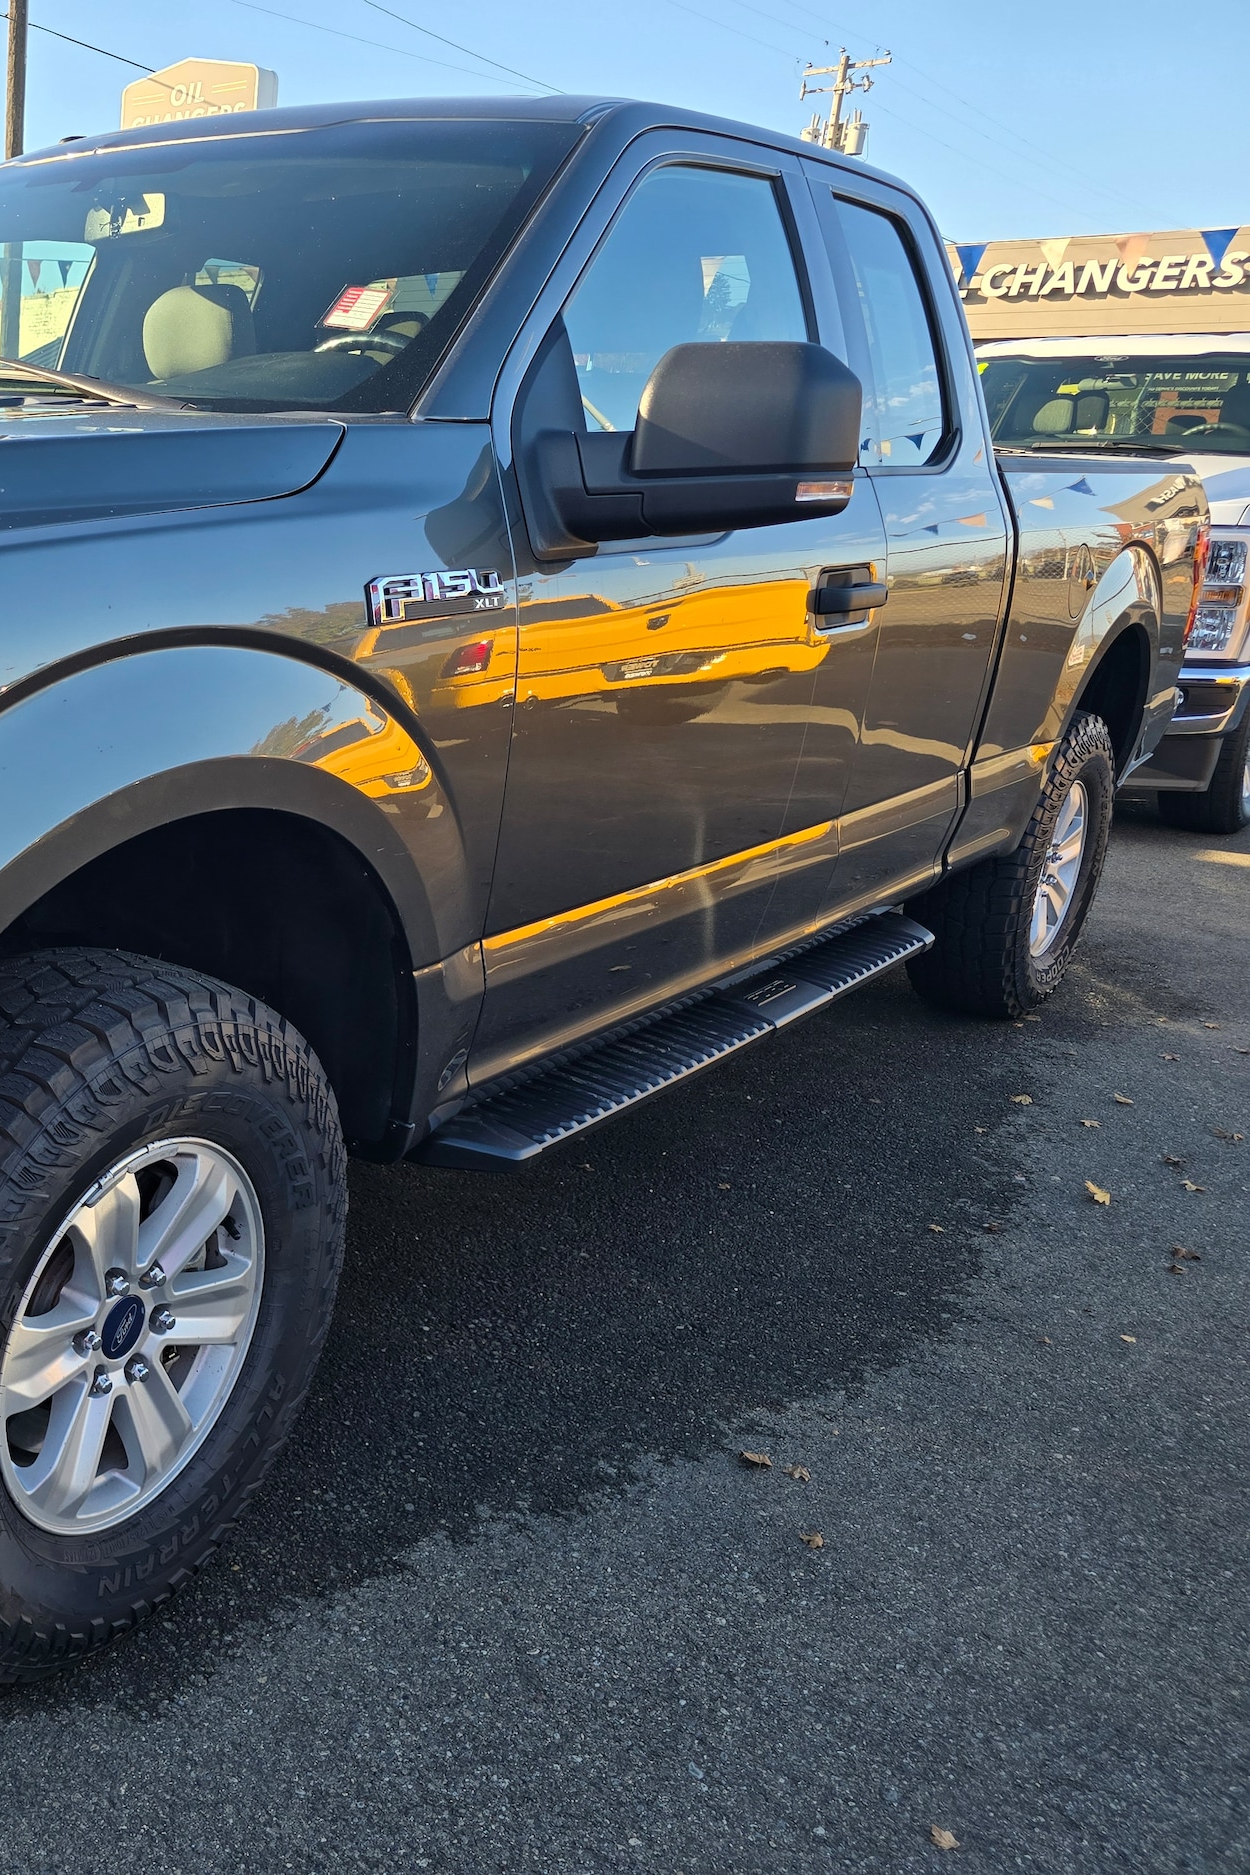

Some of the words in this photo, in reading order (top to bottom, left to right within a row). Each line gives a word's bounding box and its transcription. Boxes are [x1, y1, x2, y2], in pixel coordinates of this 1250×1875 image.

[170, 82, 205, 106] OIL
[981, 251, 1250, 297] CHANGERS
[475, 597, 500, 609] XLT
[1036, 945, 1070, 982] COOPER
[142, 1091, 315, 1209] DISCOVERER
[116, 1312, 133, 1344] Ford
[98, 1373, 288, 1598] ALL-TERRAIN
